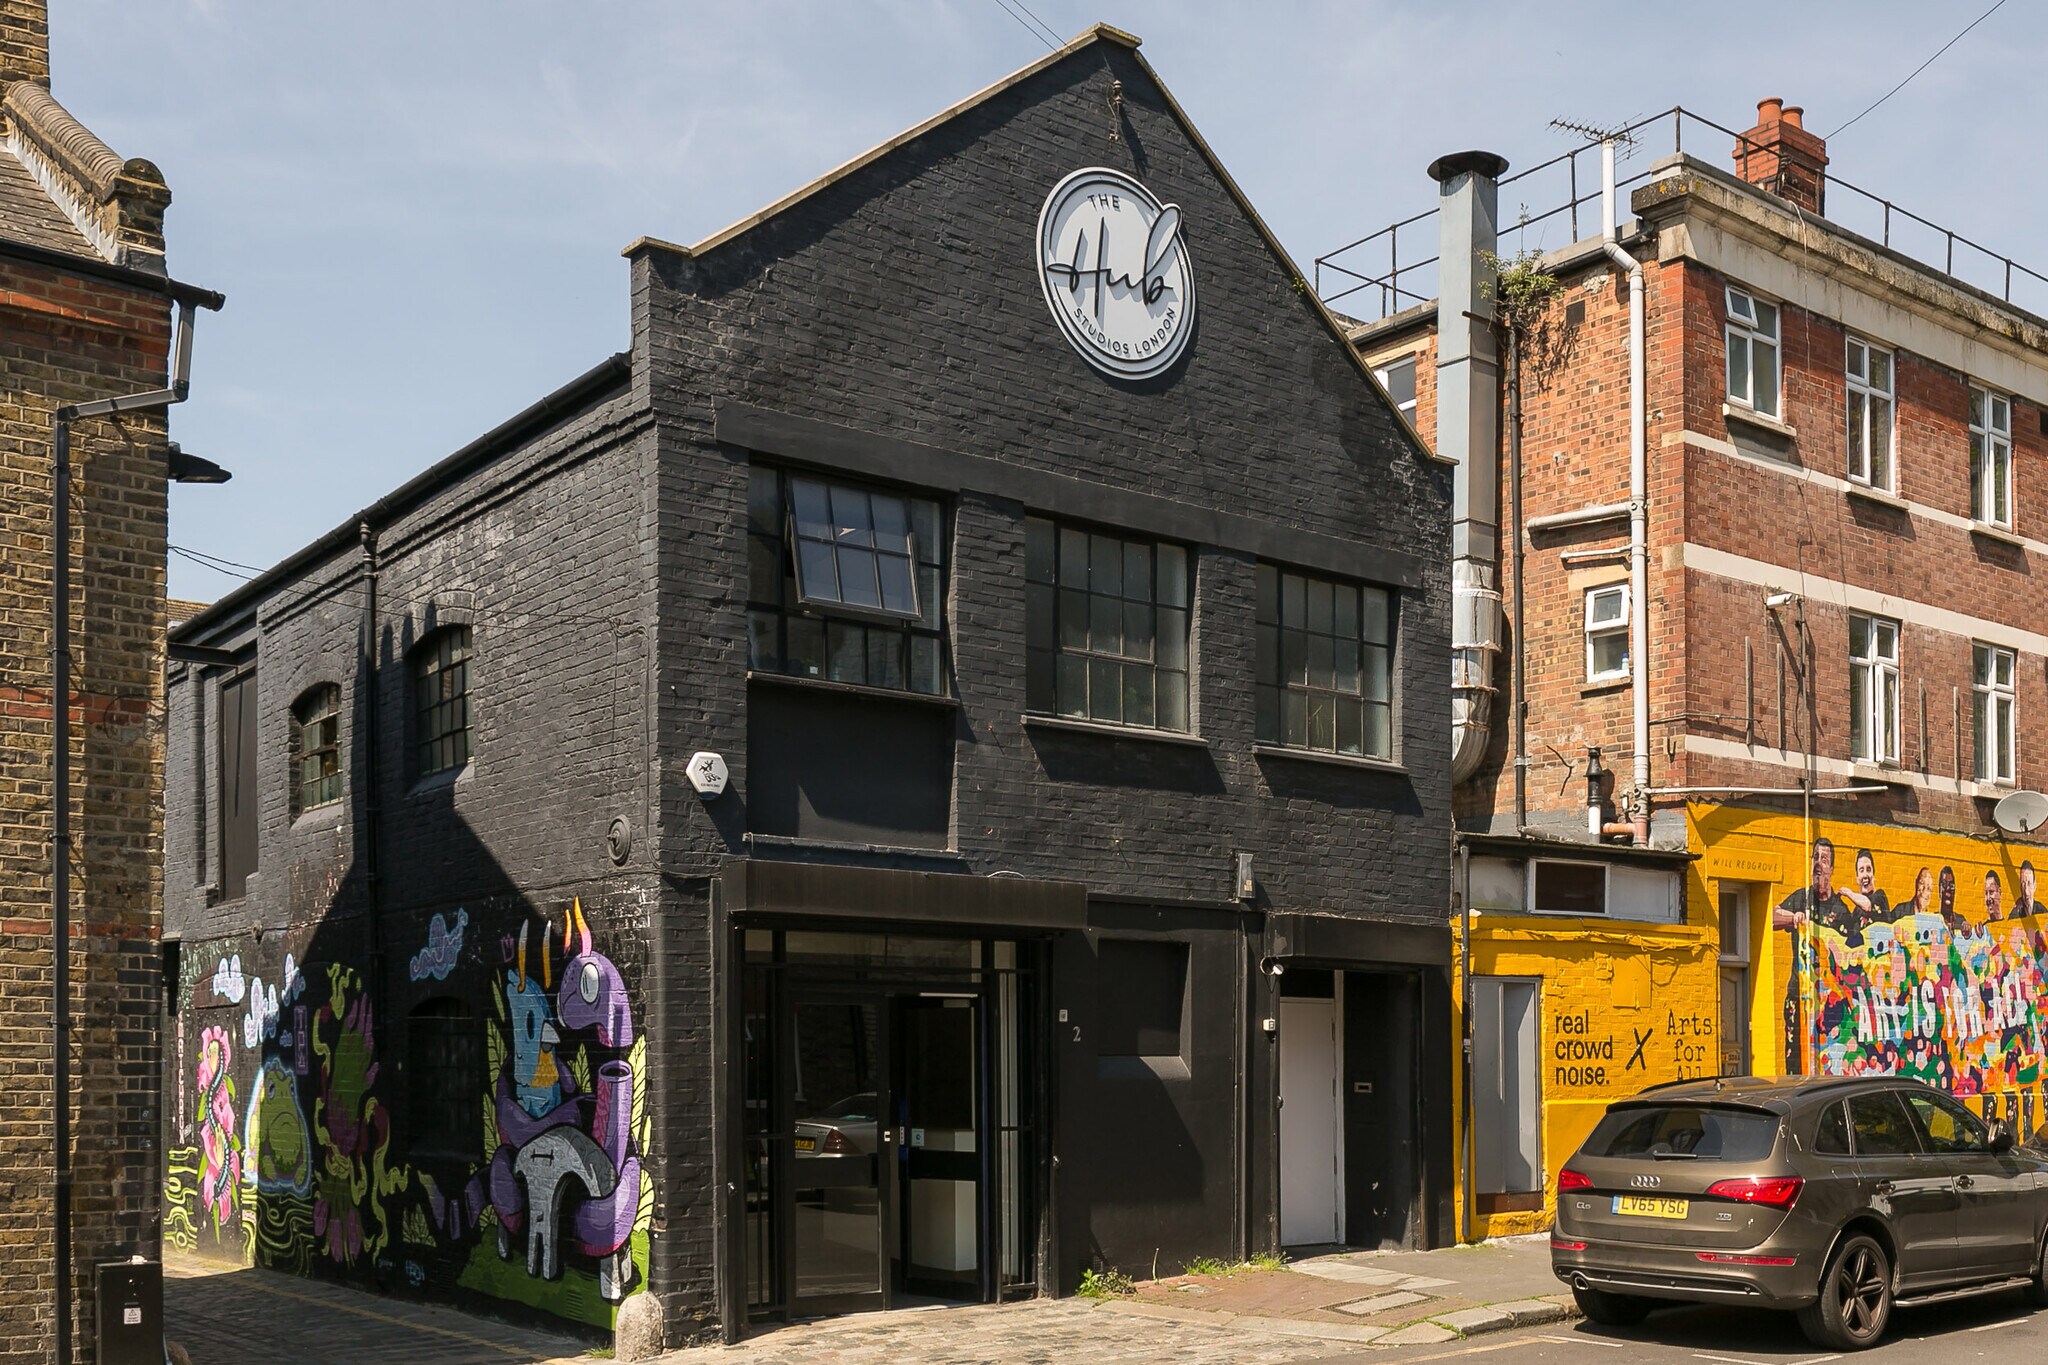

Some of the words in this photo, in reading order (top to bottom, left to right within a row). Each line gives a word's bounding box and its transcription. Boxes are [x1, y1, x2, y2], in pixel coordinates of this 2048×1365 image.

[1087, 194, 1121, 211] THE
[1046, 204, 1181, 318] Hub
[1073, 307, 1130, 356] STUDIOS
[1135, 307, 1177, 355] LONDON
[1713, 857, 1732, 869] WILL
[1736, 859, 1778, 873] REDGROVE
[1856, 986, 1901, 1042] ART
[1912, 979, 1936, 1038] IS
[1941, 986, 1984, 1040] FOR
[1991, 972, 2028, 1031] ALL
[1072, 1025, 1081, 1042] 2
[1555, 1009, 1589, 1035] real
[1666, 1008, 1713, 1036] Arts
[1555, 1035, 1613, 1060] crowd
[1673, 1038, 1706, 1062] for
[1555, 1065, 1610, 1086] noise.
[1621, 1196, 1655, 1212] LV65
[1660, 1199, 1686, 1214] YSG
